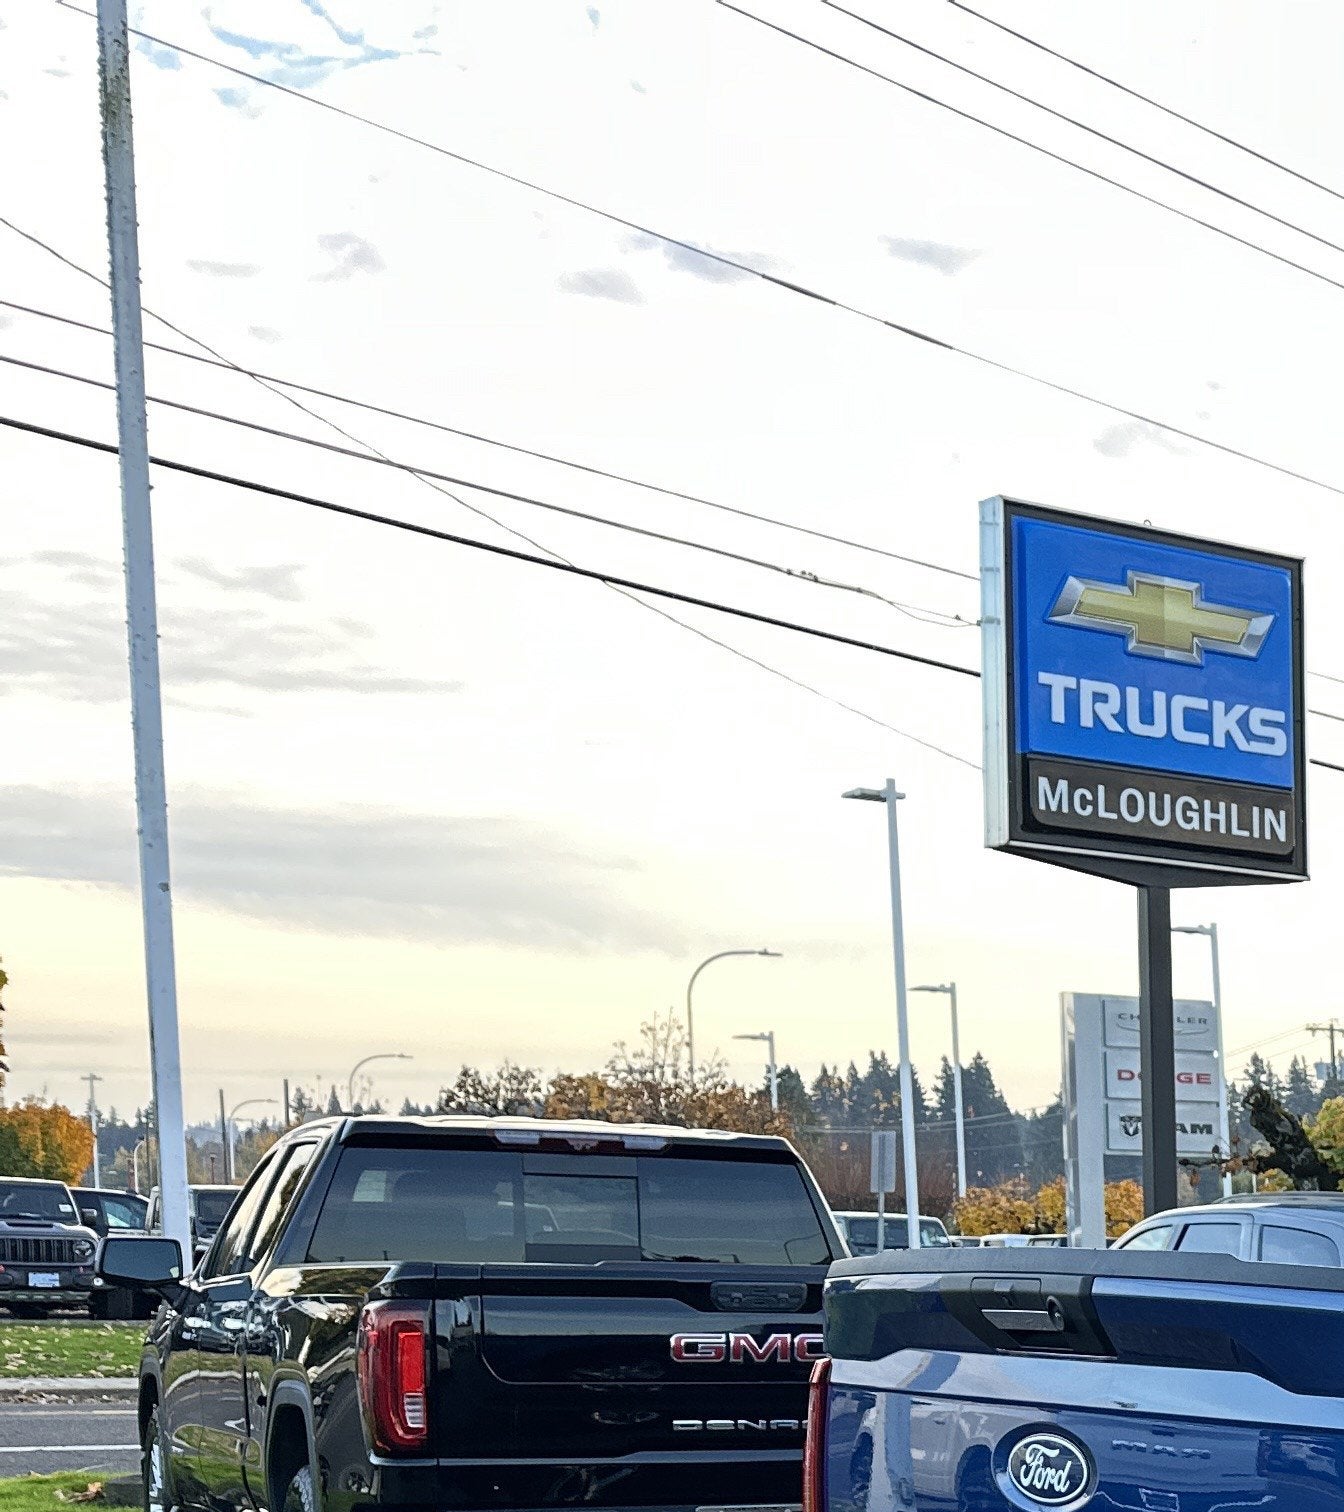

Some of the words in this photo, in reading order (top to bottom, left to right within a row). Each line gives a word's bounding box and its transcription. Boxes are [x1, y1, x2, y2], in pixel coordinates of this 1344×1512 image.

[1037, 671, 1288, 757] TRUCKS
[1037, 775, 1287, 843] McLOUGHLIN
[1117, 1012, 1208, 1025] CHLER
[1117, 1069, 1211, 1085] DGE
[1174, 1122, 1213, 1135] AM
[670, 1333, 824, 1363] GMC
[672, 1419, 809, 1431] DENA
[1019, 1442, 1072, 1493] Ford
